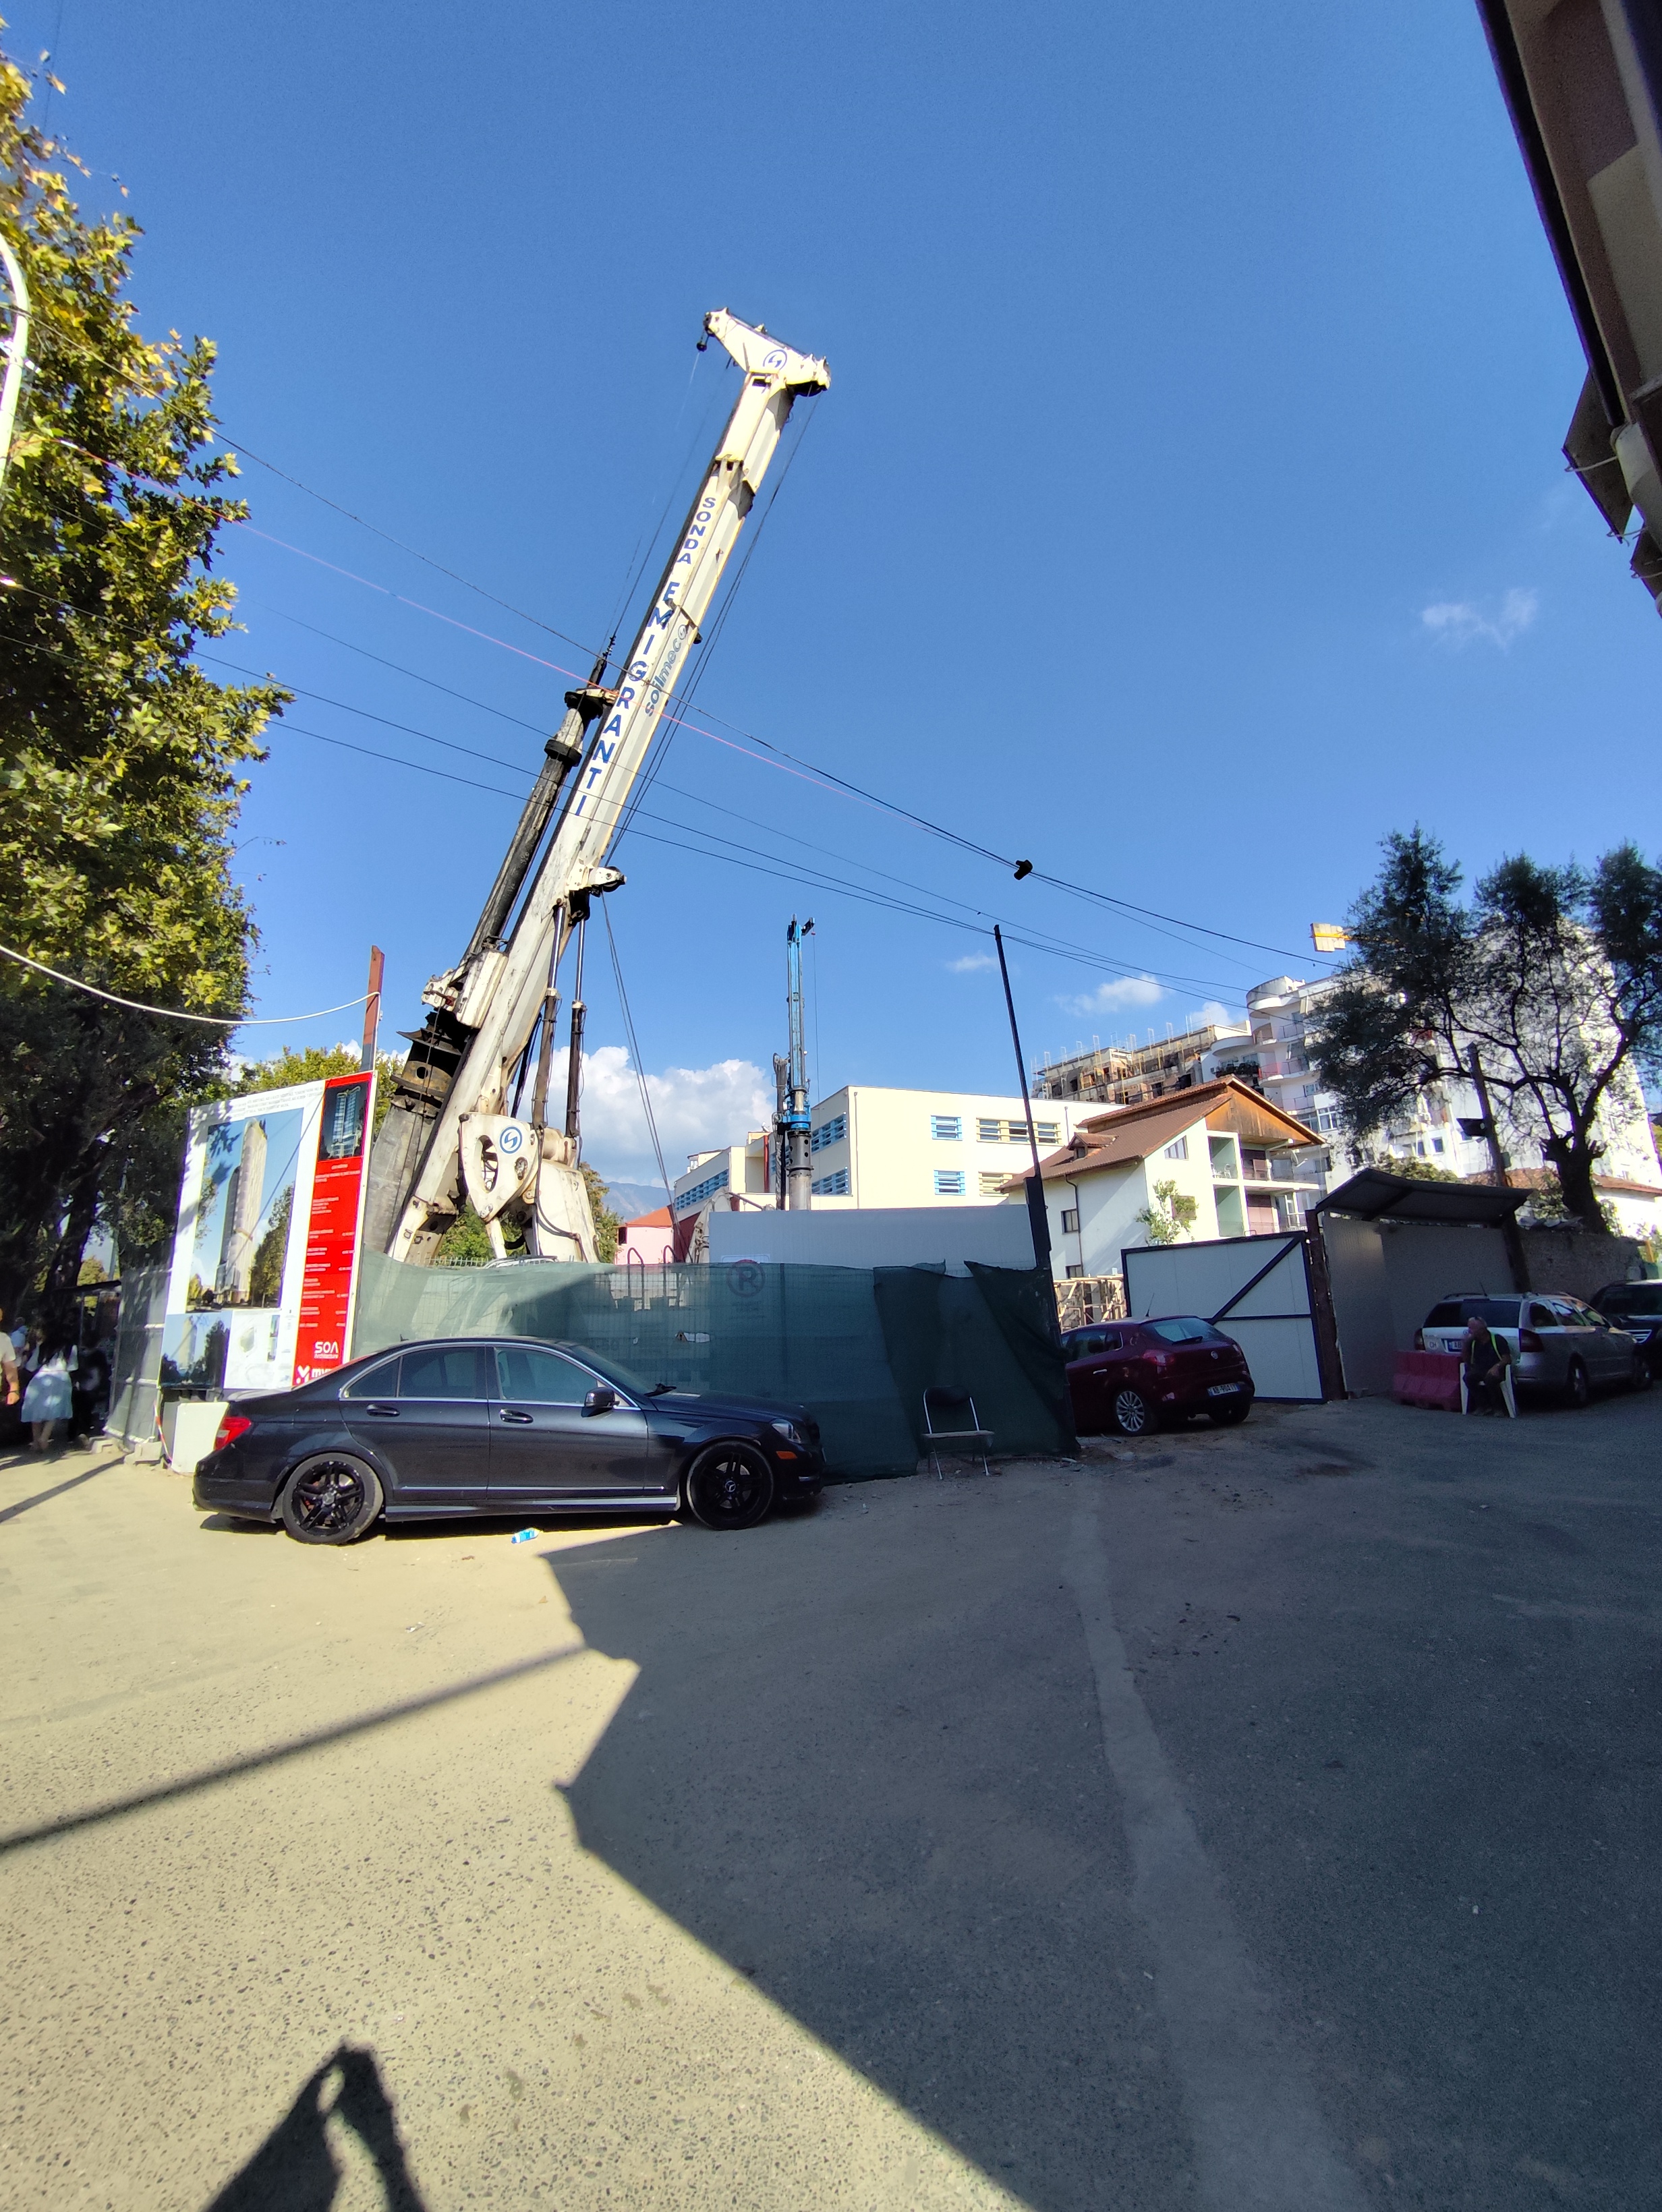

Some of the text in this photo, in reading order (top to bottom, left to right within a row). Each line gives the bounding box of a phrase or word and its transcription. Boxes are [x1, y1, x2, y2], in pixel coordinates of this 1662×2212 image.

[575, 497, 716, 817] SONDA EMIGRANTI
[645, 637, 683, 717] soilmec
[314, 1341, 339, 1354] SOA
